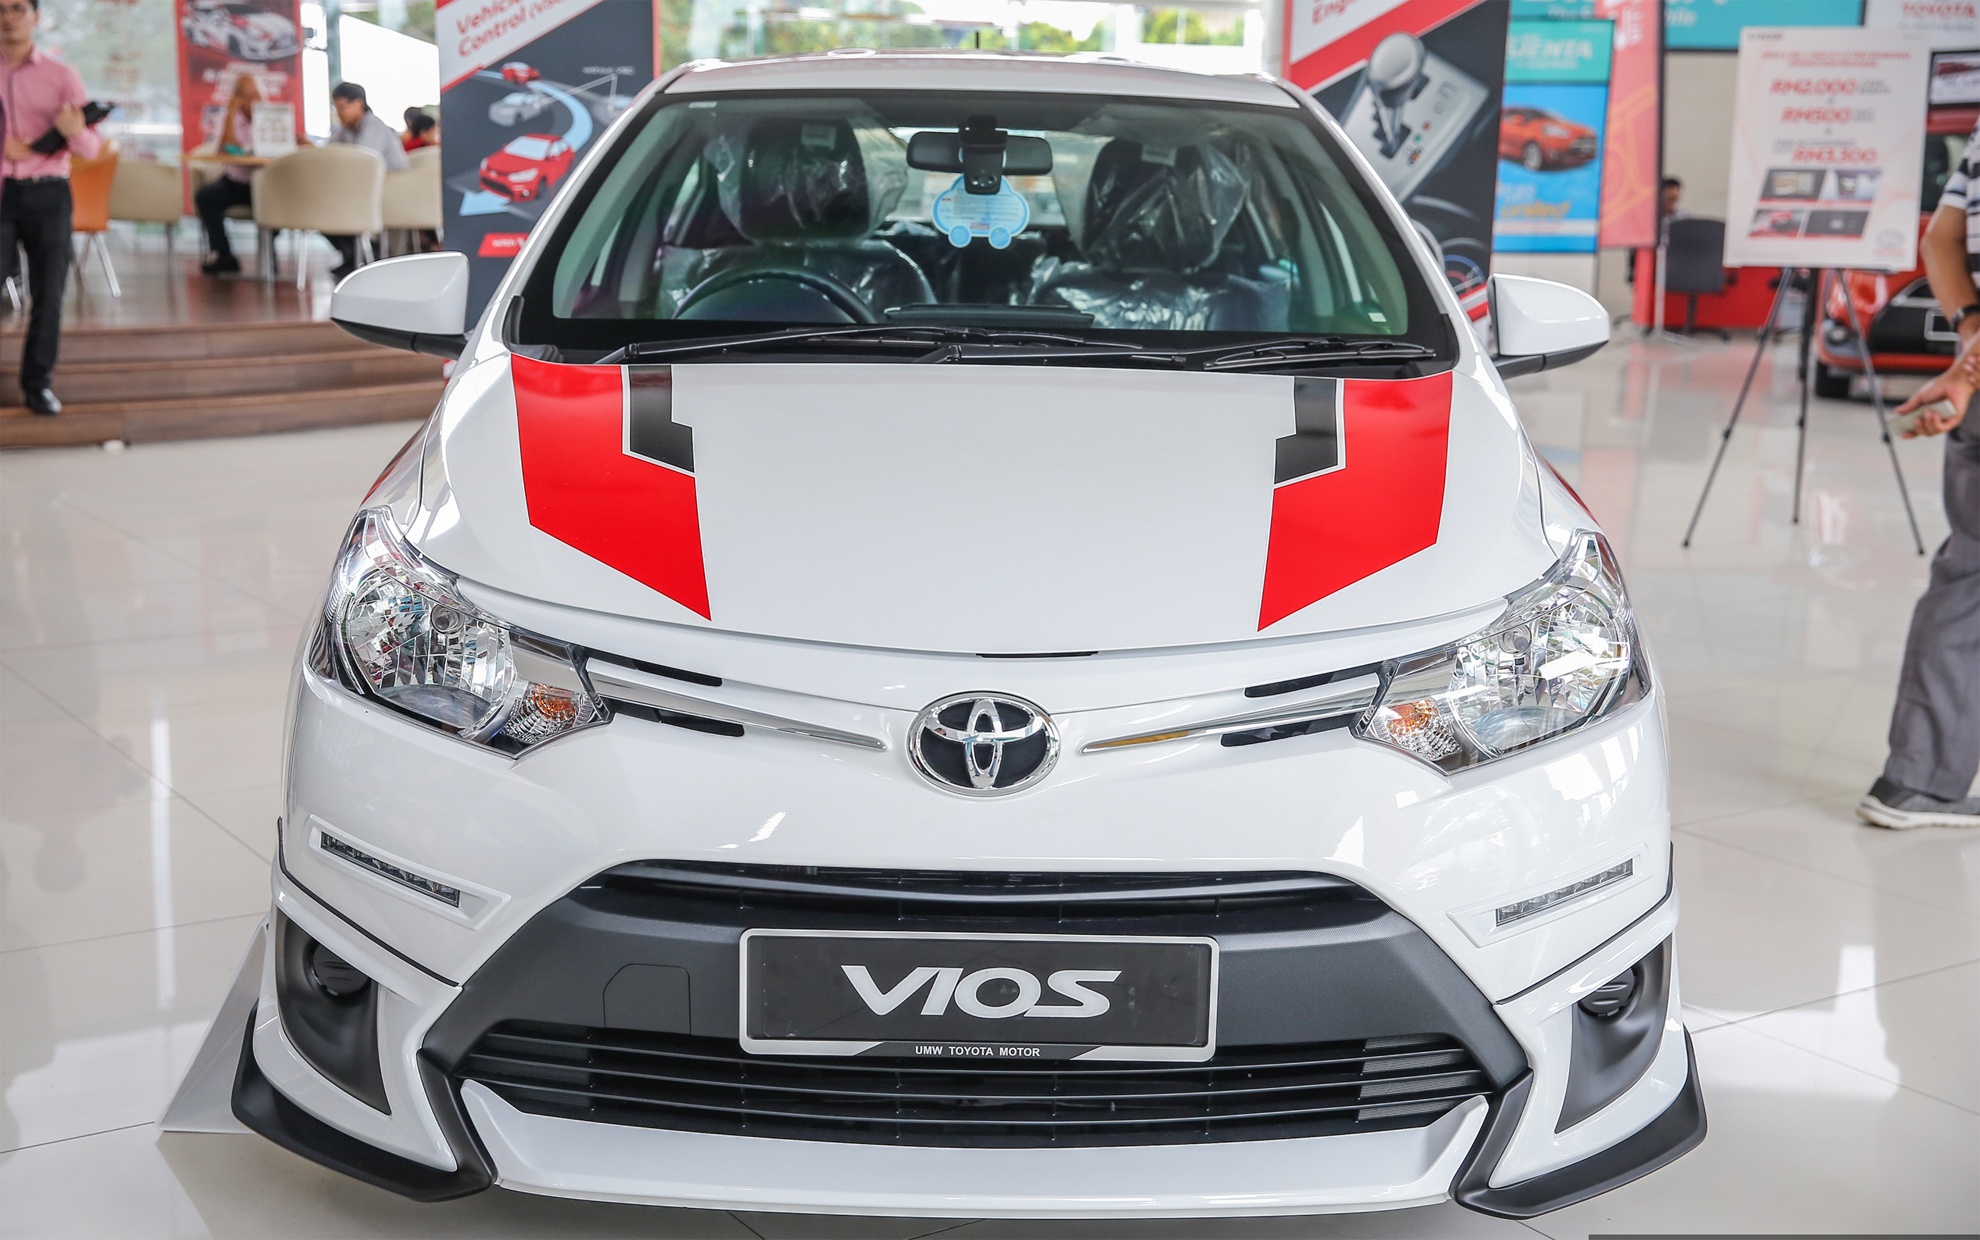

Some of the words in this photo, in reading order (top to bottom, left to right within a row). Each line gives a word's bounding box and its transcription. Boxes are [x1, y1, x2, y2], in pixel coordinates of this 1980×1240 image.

[458, 6, 526, 57] Control
[840, 965, 1123, 1019] VIOS
[915, 1045, 943, 1055] UMW
[949, 1046, 994, 1056] TOYOTA
[999, 1047, 1040, 1057] MOTOR
